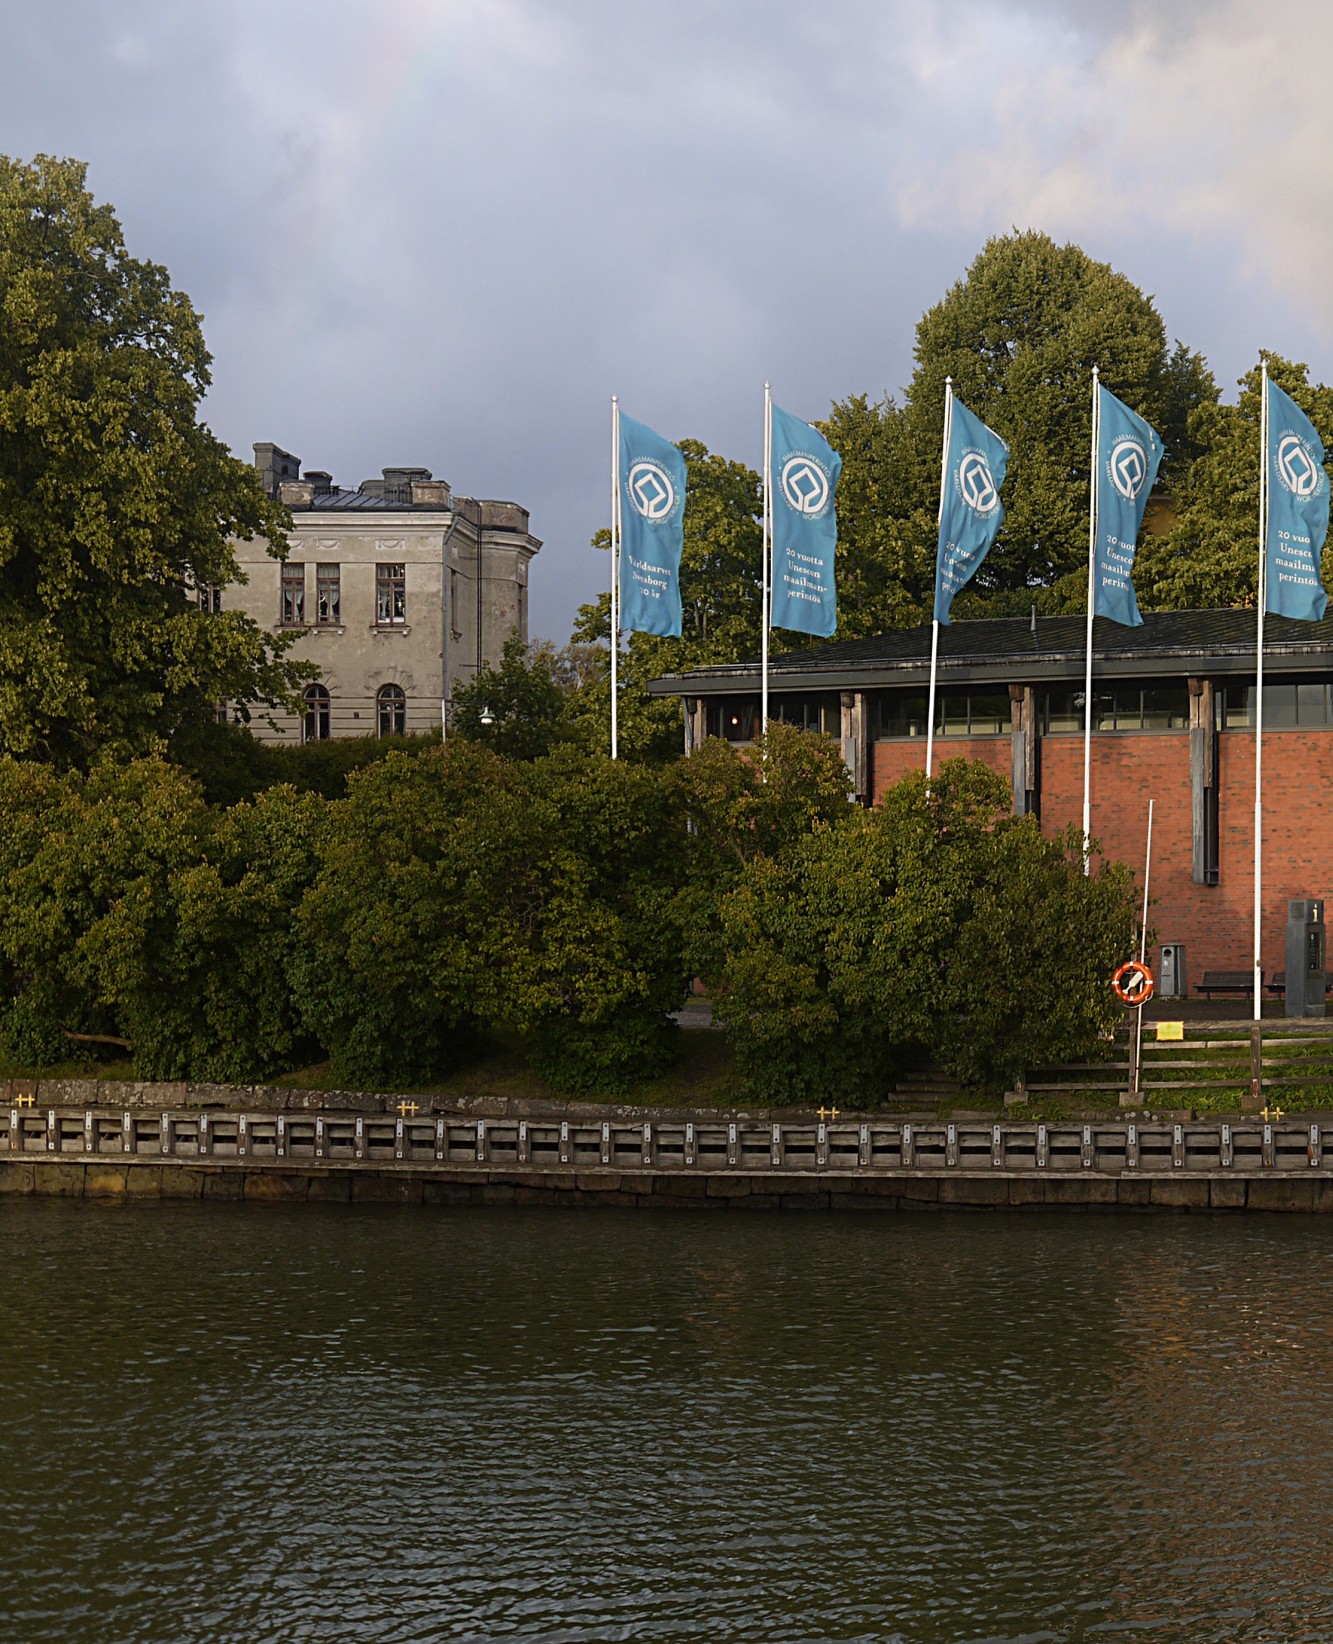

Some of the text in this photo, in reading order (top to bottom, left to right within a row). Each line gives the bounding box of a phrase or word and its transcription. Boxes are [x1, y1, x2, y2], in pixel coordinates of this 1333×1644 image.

[1107, 535, 1118, 545] 20
[1278, 530, 1290, 540] 20
[946, 541, 955, 551] 20
[786, 547, 824, 566] 20 vuotta
[788, 560, 821, 579] Unescon
